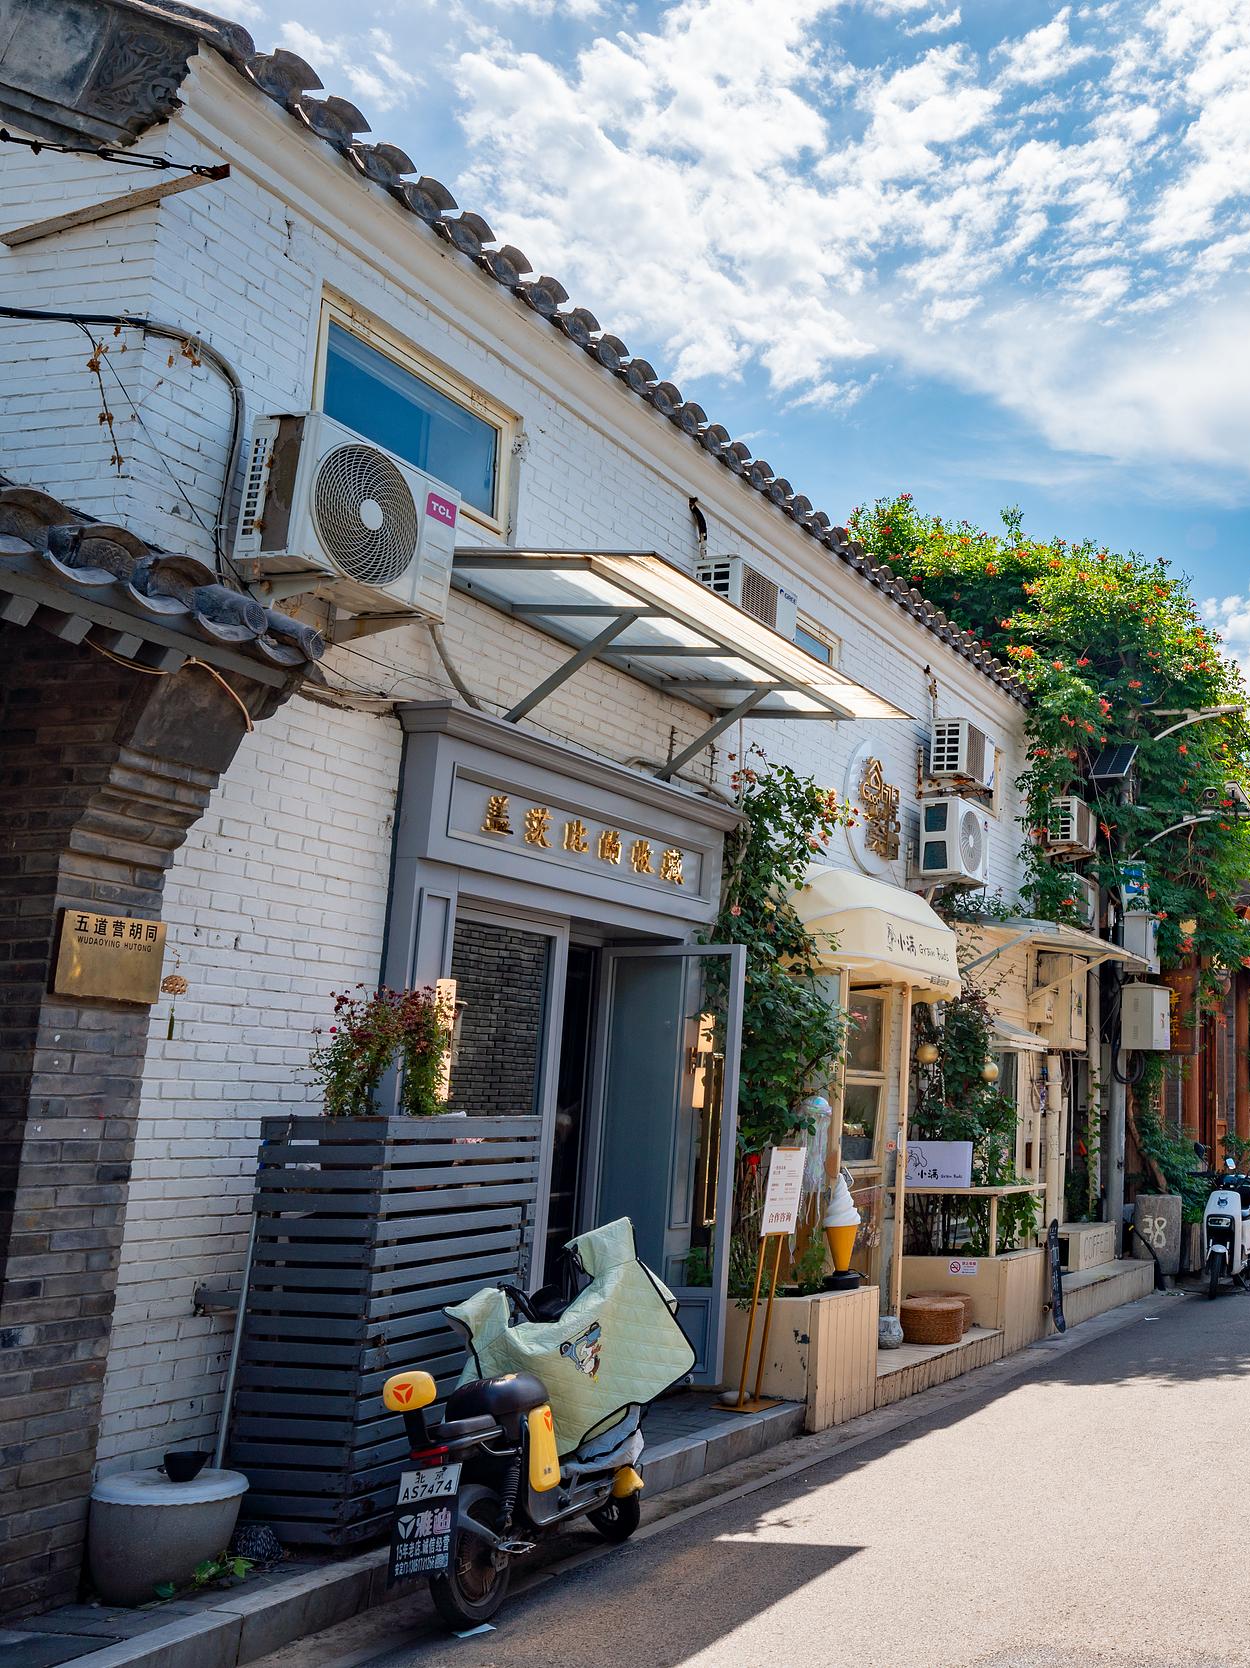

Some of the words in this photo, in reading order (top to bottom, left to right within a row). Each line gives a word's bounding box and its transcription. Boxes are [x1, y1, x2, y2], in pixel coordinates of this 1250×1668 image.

[431, 500, 452, 520] TCL
[481, 795, 685, 885] 盖茨比的收藏
[74, 914, 158, 942] 五道营胡同
[77, 935, 120, 949] WUDAOYING
[124, 943, 152, 953] HUTONG
[918, 1169, 939, 1180] 小满
[768, 1212, 792, 1223] 合作咨询
[402, 1480, 452, 1501] AS7474
[415, 1507, 451, 1538] 雅迪
